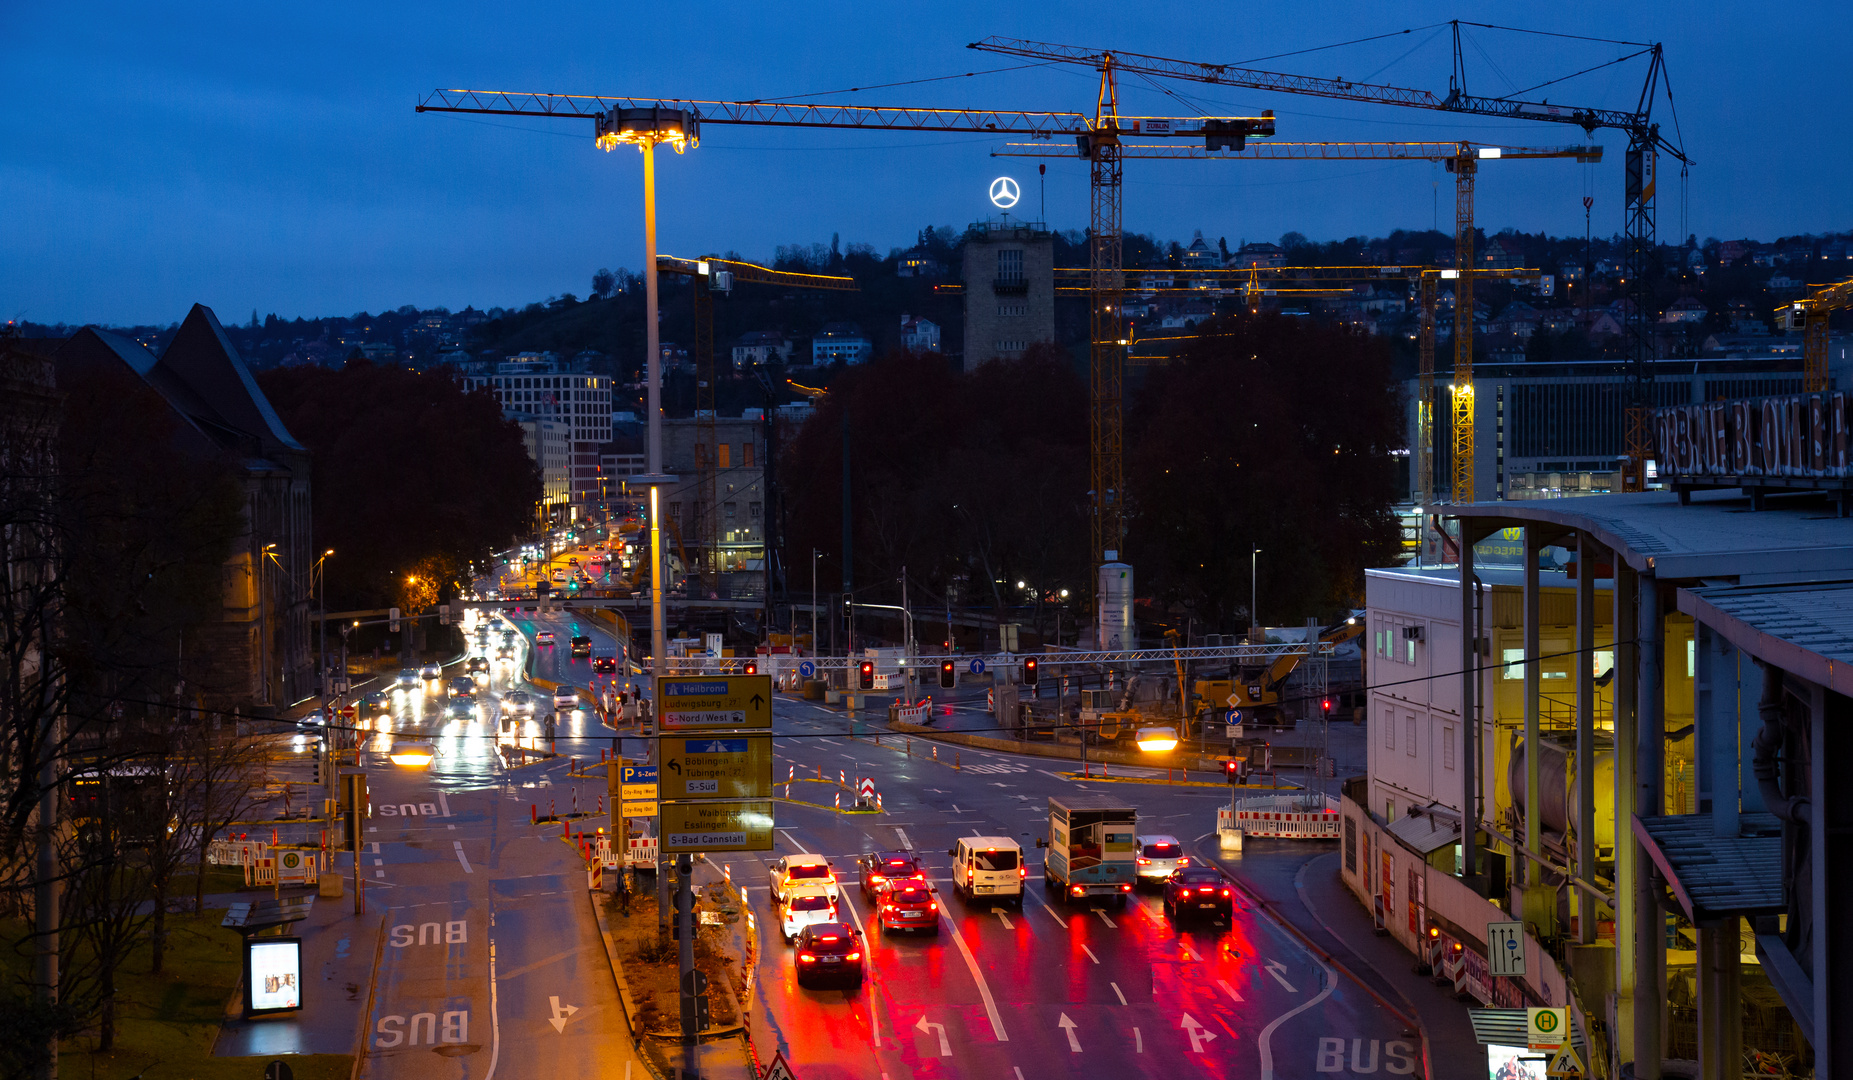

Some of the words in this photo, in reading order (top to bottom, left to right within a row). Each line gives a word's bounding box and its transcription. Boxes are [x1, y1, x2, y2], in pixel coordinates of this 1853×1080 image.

[683, 685, 727, 693] Heilbronn
[665, 700, 721, 709] Ludwigsburg
[685, 757, 729, 767] Böblingen
[686, 769, 726, 778] Tübingen
[960, 763, 1028, 775] BUS
[624, 768, 635, 781] P
[688, 782, 716, 791] S-Süd
[379, 803, 438, 816] BUS
[684, 820, 727, 830] Esslingen
[671, 836, 699, 844] S-Bad
[702, 834, 744, 844] Cannstatt
[287, 856, 296, 865] H
[390, 920, 468, 948] BUS
[1541, 1015, 1552, 1028] H
[375, 1010, 468, 1048] BUS
[1315, 1037, 1416, 1075] BUS
